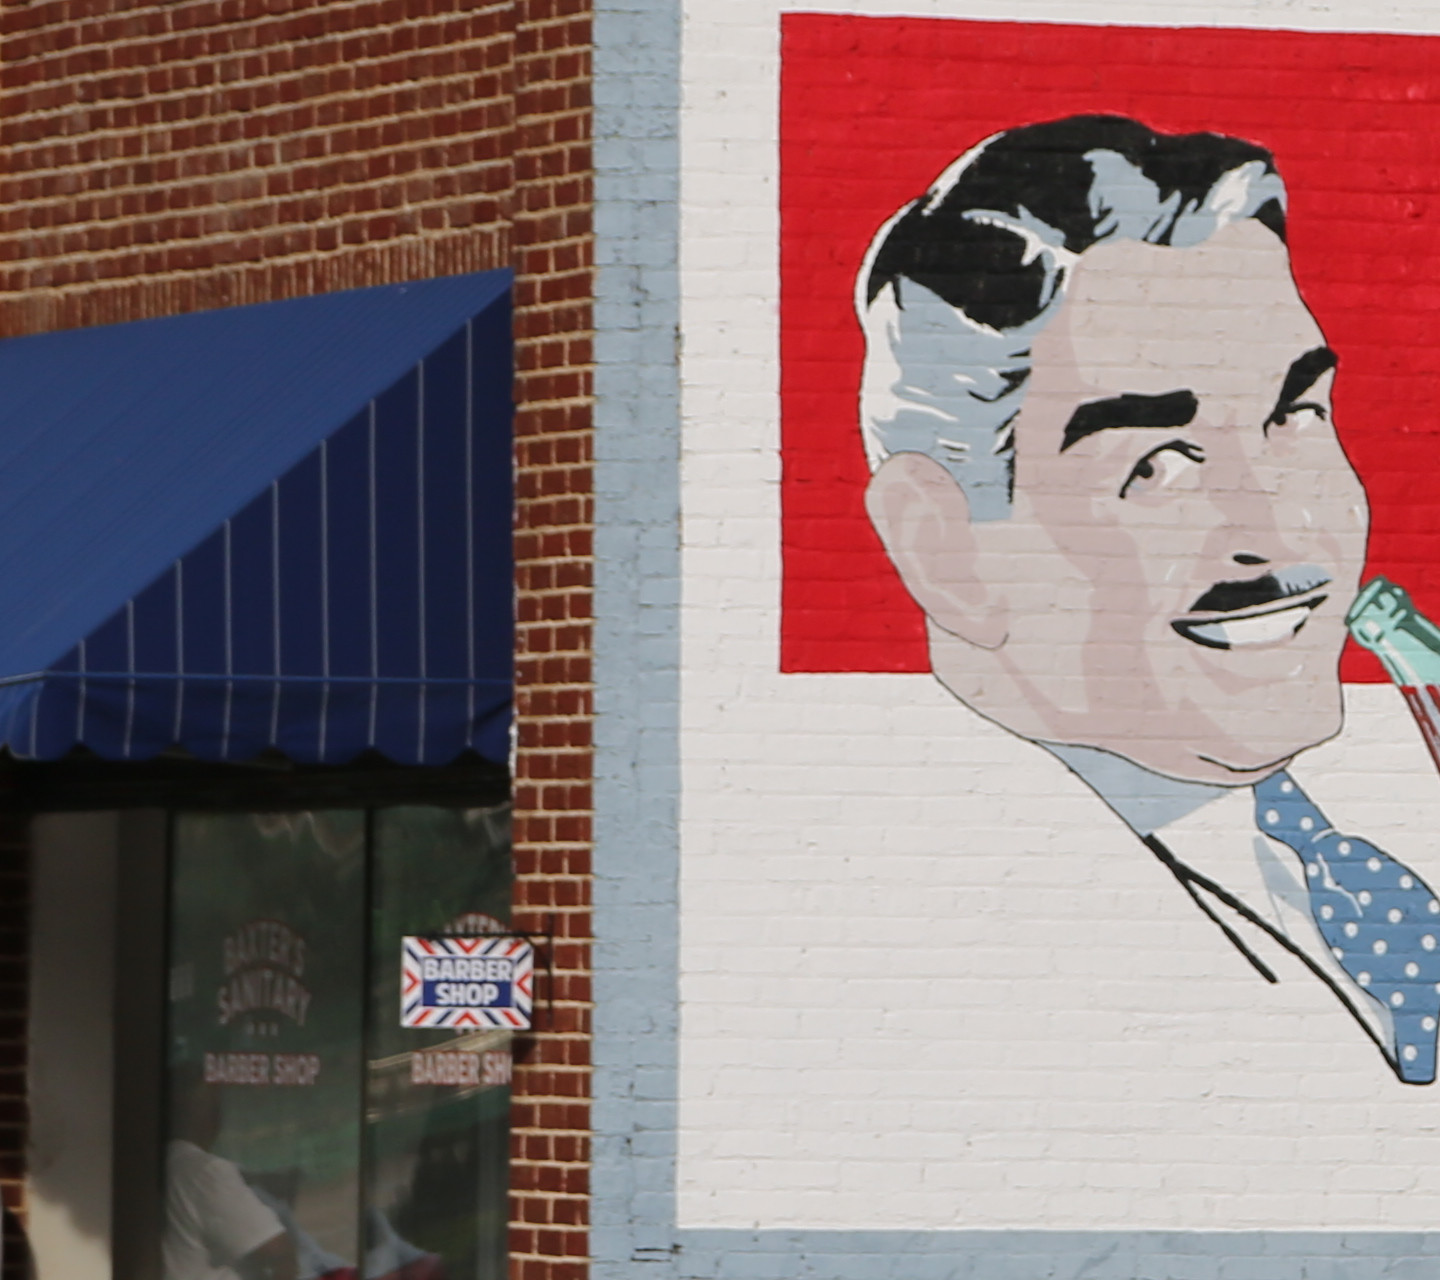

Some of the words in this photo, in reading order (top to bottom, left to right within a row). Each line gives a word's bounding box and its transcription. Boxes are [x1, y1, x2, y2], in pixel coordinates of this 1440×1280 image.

[424, 958, 513, 981] BARBER
[217, 967, 312, 1027] SANITARY
[435, 983, 499, 1006] SHOP
[203, 1052, 270, 1085] BARBER
[272, 1053, 321, 1086] SHOP
[411, 1051, 480, 1085] BARBER
